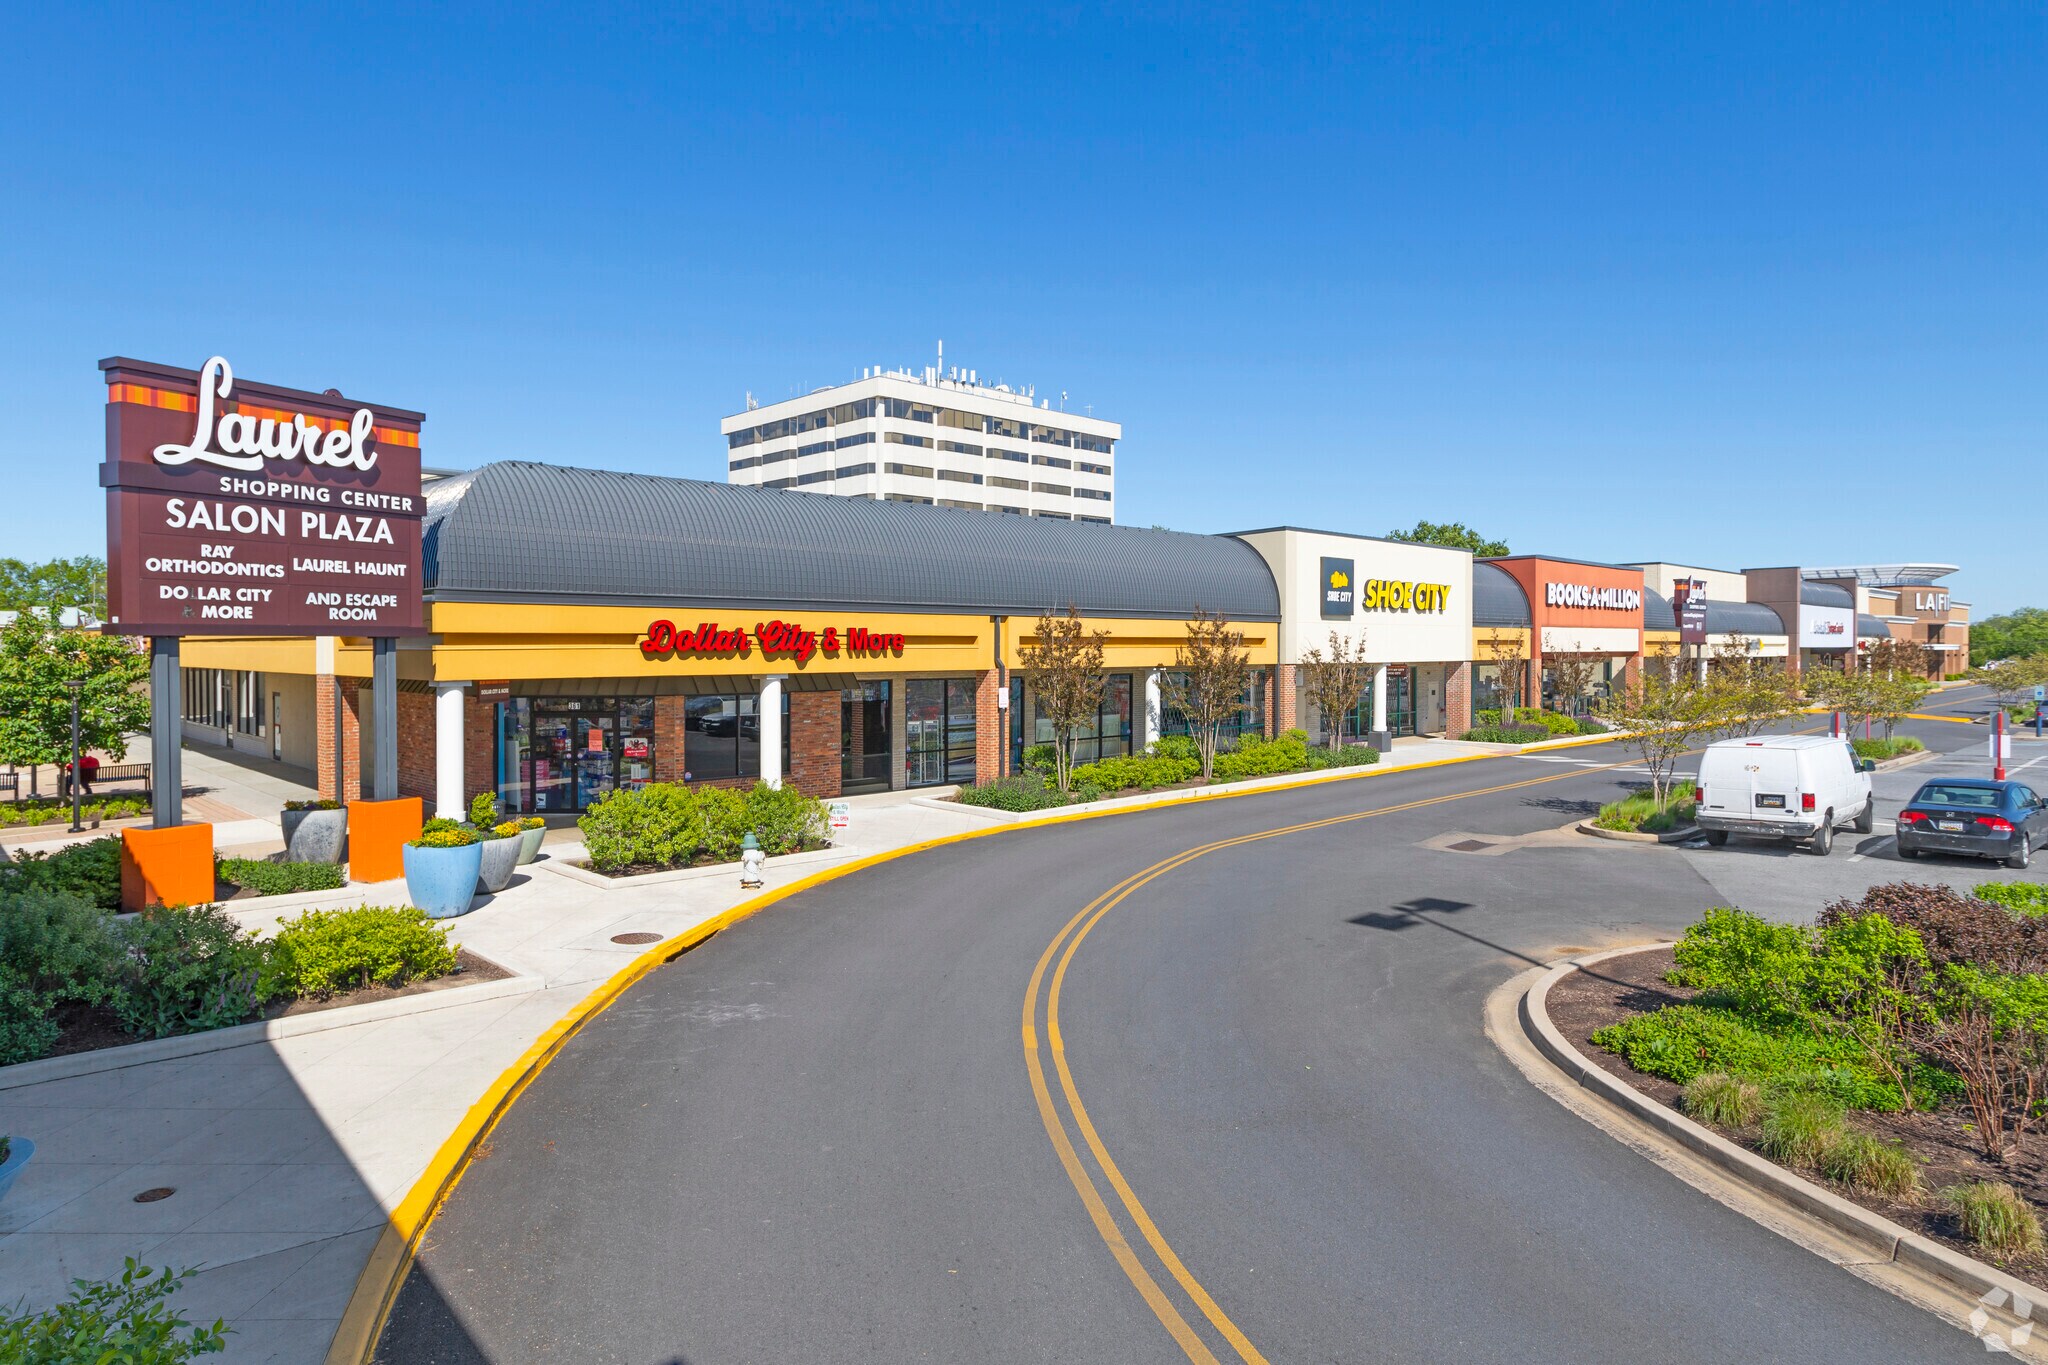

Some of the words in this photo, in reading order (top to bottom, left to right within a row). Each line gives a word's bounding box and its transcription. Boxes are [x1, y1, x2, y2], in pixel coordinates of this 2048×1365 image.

[154, 356, 377, 470] Laurel
[220, 477, 329, 502] SHOPPING
[341, 491, 411, 511] CENTER
[166, 498, 285, 536] SALON
[302, 512, 393, 544] PLAZA
[201, 544, 234, 558] RAY
[146, 557, 284, 577] ORTHODONTICS
[294, 558, 350, 573] LAUREL
[355, 562, 406, 576] HAUNT
[237, 588, 272, 601] CITY
[306, 593, 341, 605] AND
[346, 594, 397, 606] ESCAPE
[1327, 591, 1340, 601] SHOE
[1340, 592, 1352, 602] CITY
[1365, 579, 1413, 609] SHOE
[1415, 583, 1451, 610] CITY
[1916, 593, 1935, 610] LA
[202, 606, 252, 618] MORE
[330, 608, 376, 620] ROOM
[643, 620, 751, 652] Dollar
[758, 621, 817, 661] City
[824, 628, 840, 650] &
[850, 628, 904, 650] More
